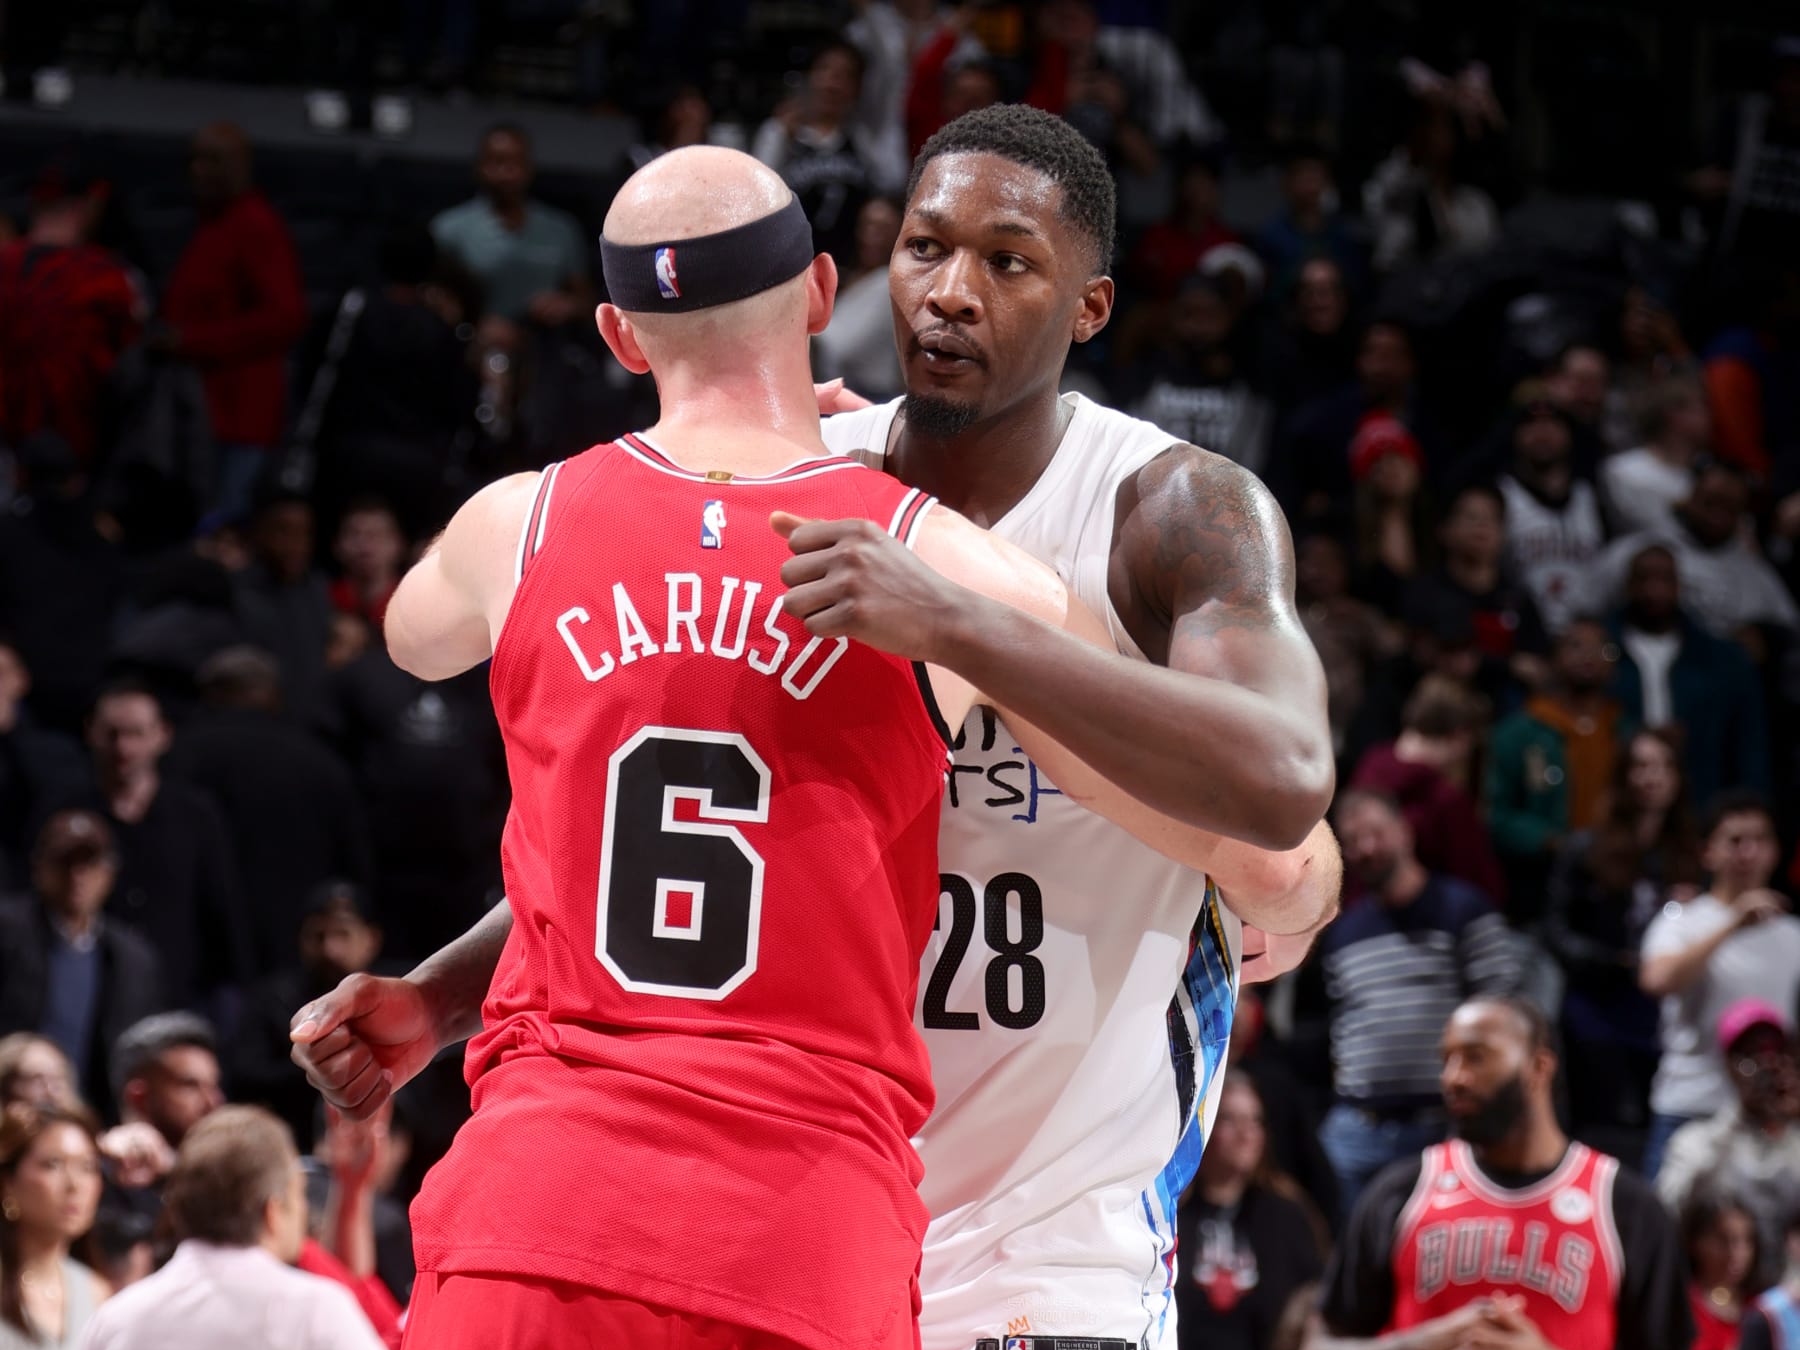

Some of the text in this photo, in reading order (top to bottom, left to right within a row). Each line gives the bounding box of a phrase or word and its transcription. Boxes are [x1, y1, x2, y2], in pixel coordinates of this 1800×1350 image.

[556, 573, 848, 700] CARUSO
[950, 761, 1025, 808] TS
[595, 725, 772, 1001] 6
[923, 872, 1046, 1030] 28
[1415, 1217, 1595, 1314] BULLS
